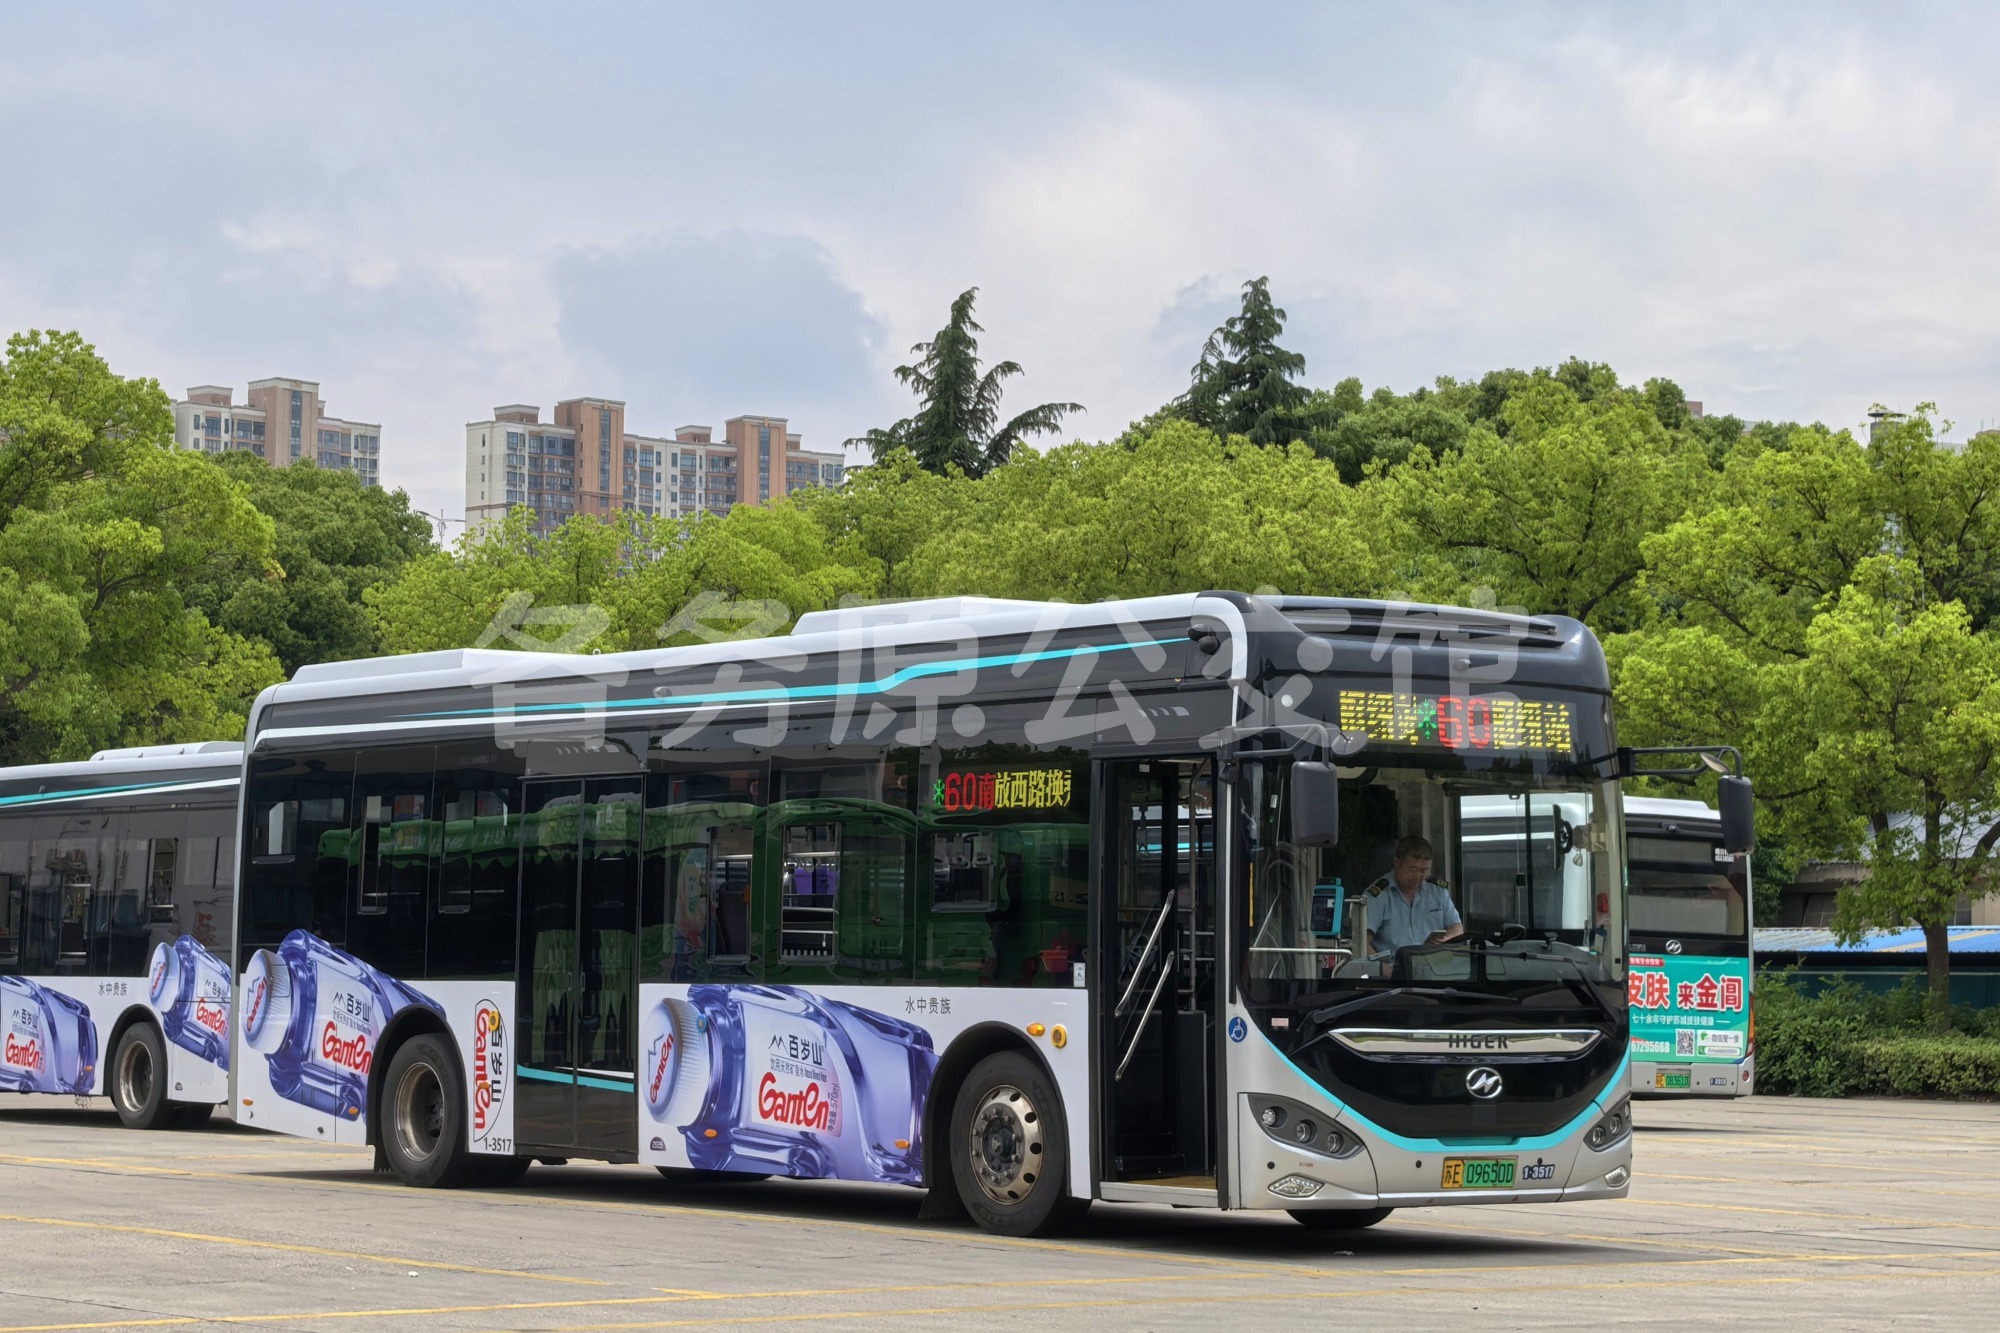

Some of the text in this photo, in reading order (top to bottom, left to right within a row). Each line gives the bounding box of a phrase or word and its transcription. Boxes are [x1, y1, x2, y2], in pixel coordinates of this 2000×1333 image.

[1437, 696, 1491, 748] 60
[98, 982, 128, 996] 水中贵族
[905, 996, 951, 1015] 水中贵族
[5, 1032, 40, 1070] Ganten
[322, 1020, 372, 1075] Ganten
[788, 1033, 823, 1066] 百岁山
[1449, 1034, 1508, 1049] HIGER
[758, 1071, 829, 1131] Ganten
[483, 1137, 512, 1153] 1-3517
[1523, 1164, 1555, 1180] 1-3517
